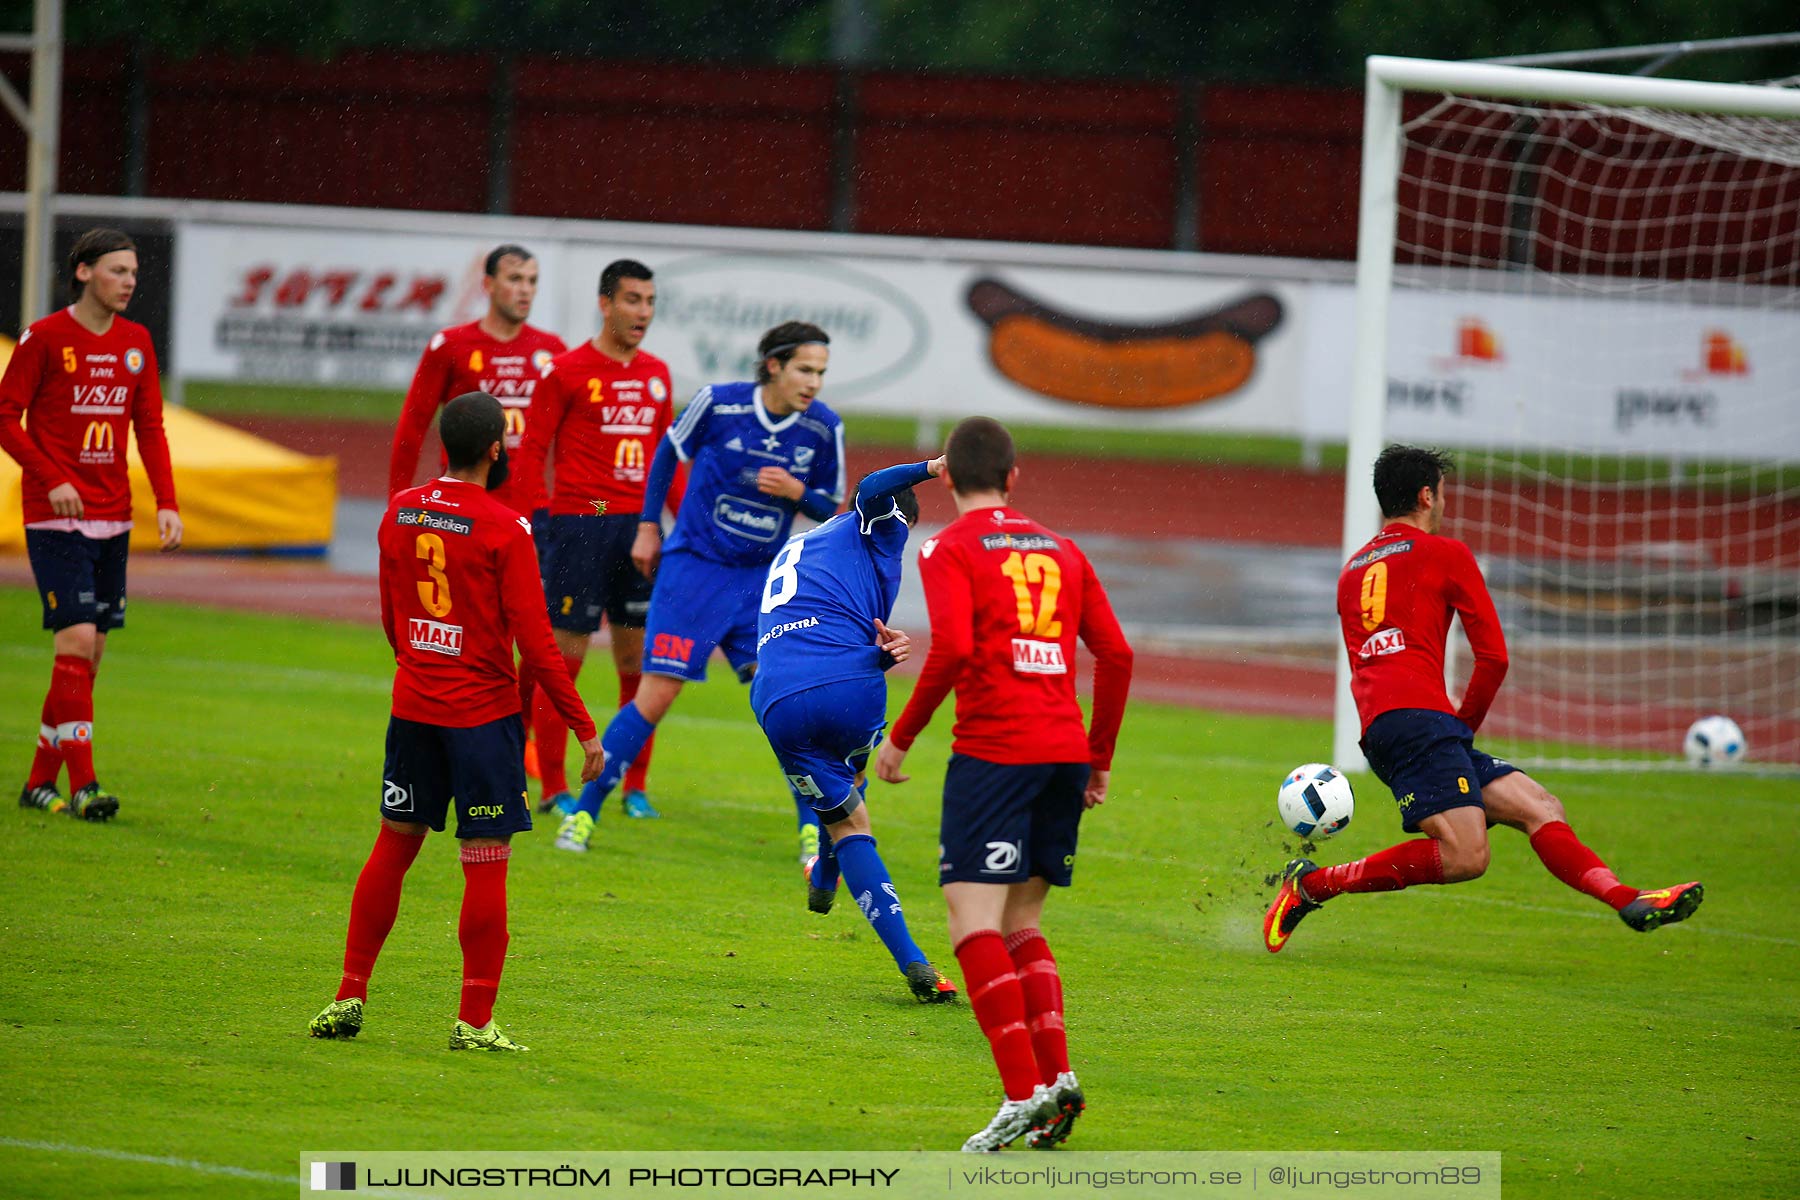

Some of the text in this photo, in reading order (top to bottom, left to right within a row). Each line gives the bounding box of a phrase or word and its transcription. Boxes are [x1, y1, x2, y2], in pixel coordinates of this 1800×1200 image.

[62, 346, 77, 373] 5
[469, 350, 484, 372] 4
[587, 378, 604, 403] 2
[416, 532, 453, 618] 3
[760, 538, 805, 614] 8
[1000, 551, 1063, 639] 12
[1360, 561, 1388, 632] 9
[410, 621, 462, 649] MAXI
[783, 616, 820, 632] EXTRA
[651, 632, 696, 663] SN
[1014, 642, 1065, 666] MAXI
[1457, 776, 1470, 794] 9
[468, 804, 505, 819] onyx
